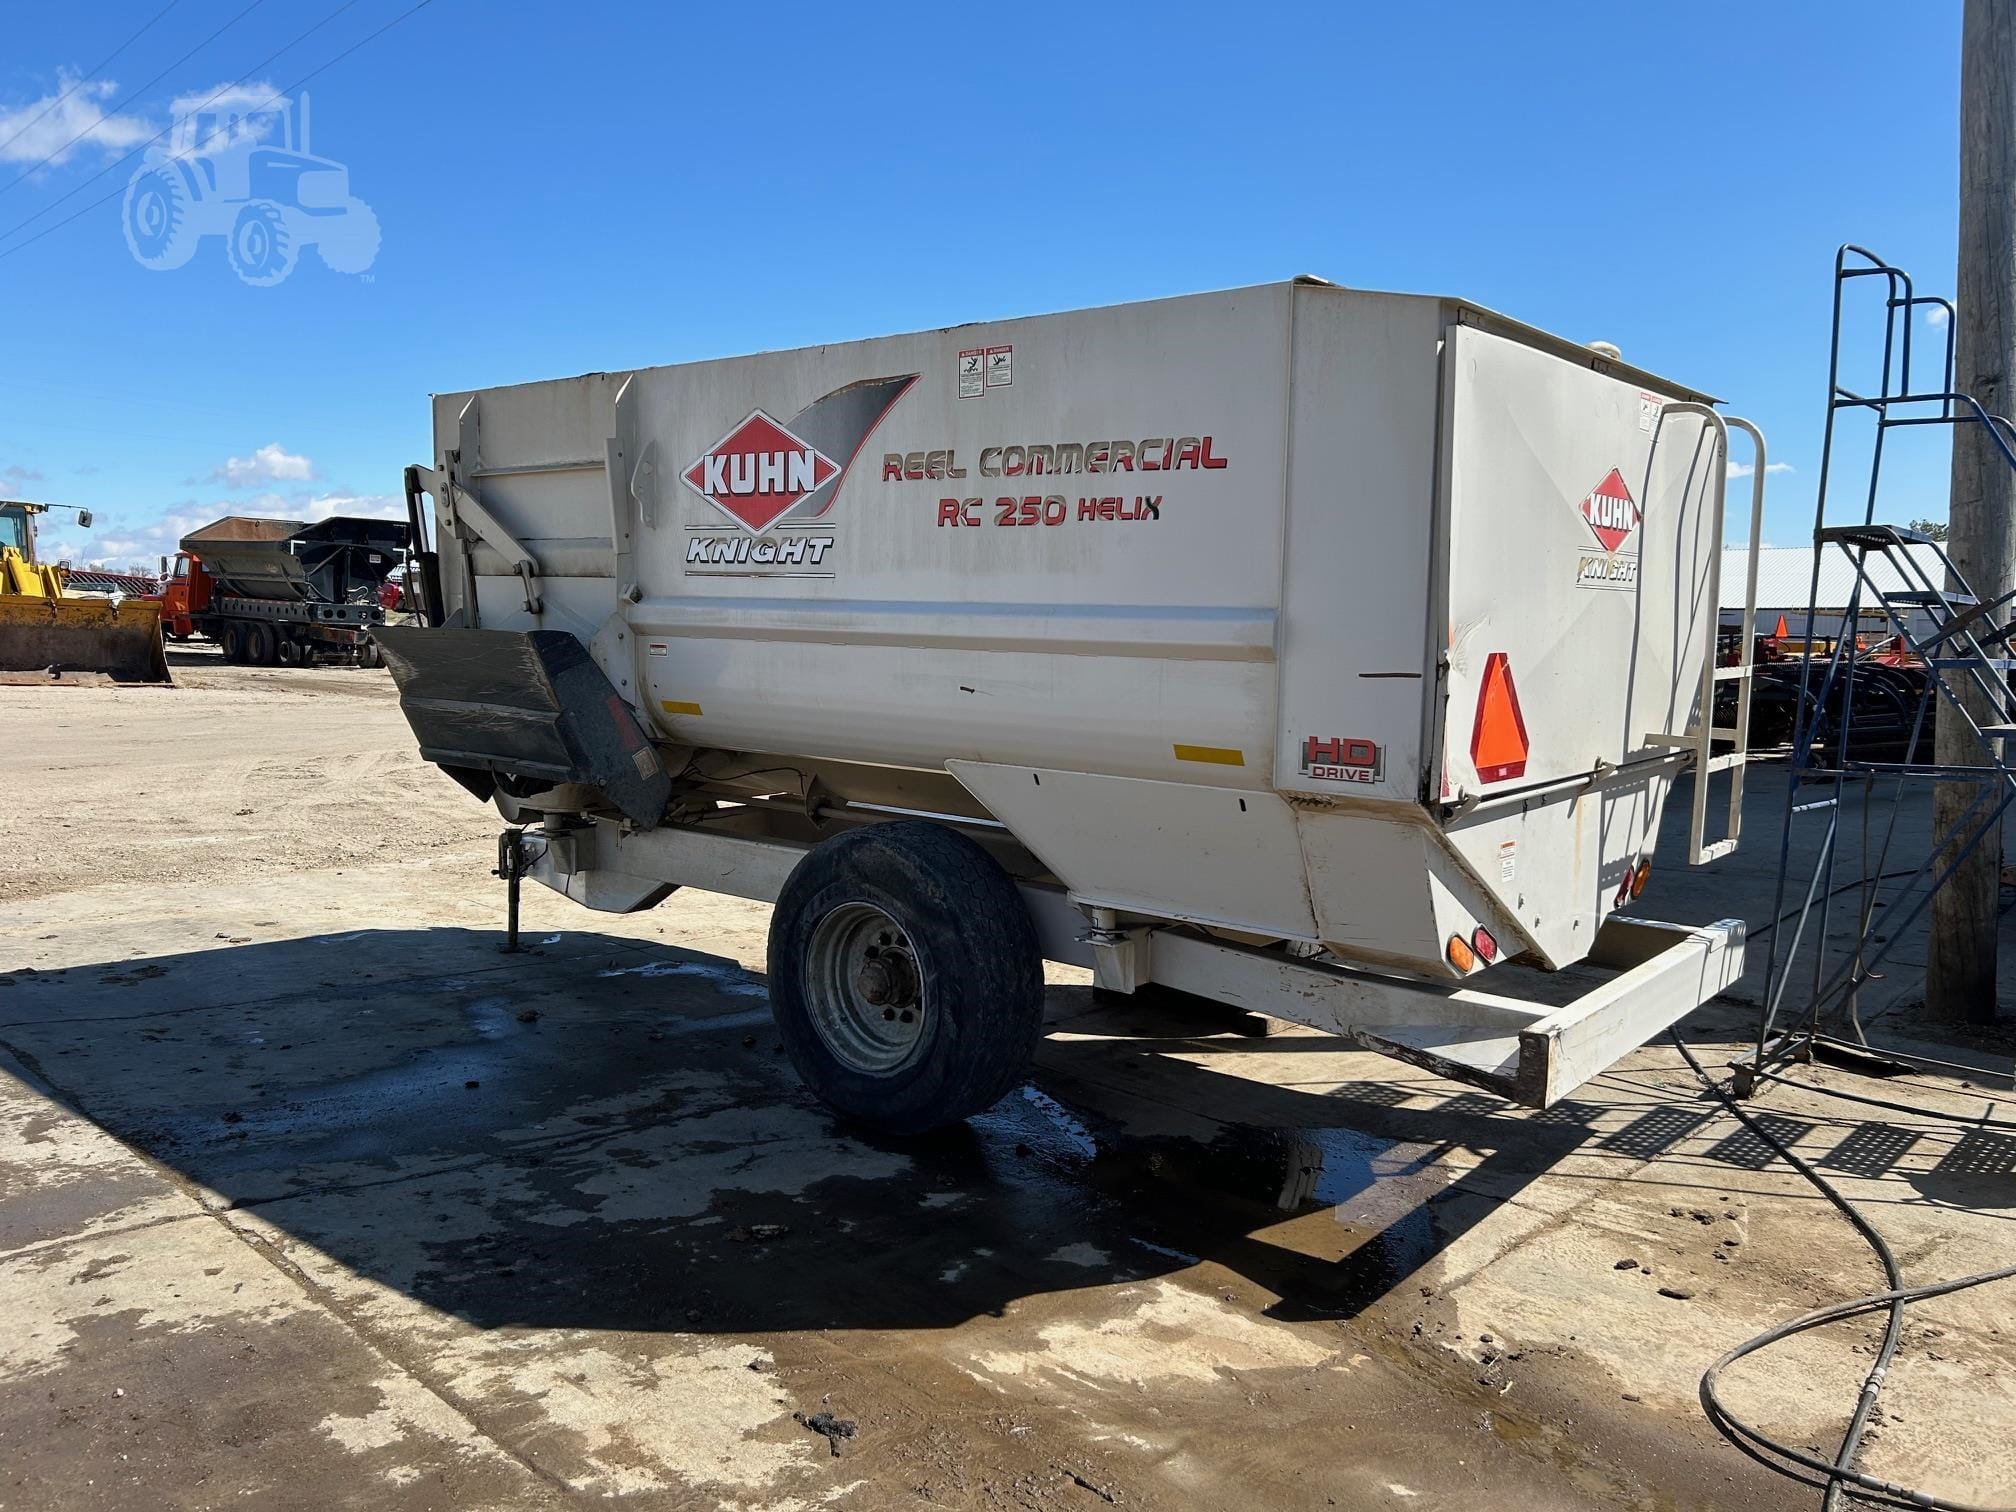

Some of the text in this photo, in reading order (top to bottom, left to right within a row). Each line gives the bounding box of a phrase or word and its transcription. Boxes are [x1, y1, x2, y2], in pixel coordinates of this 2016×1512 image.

[703, 449, 816, 496] KUHN
[882, 437, 1228, 482] REEL COMMERCIAL
[937, 494, 1163, 527] RC 250 HELIX
[1589, 493, 1635, 532] KUHN
[686, 537, 834, 565] KNIGHT
[1577, 557, 1637, 583] KNIGHT
[1307, 735, 1377, 767] HD
[1312, 766, 1371, 781] DRIVE
